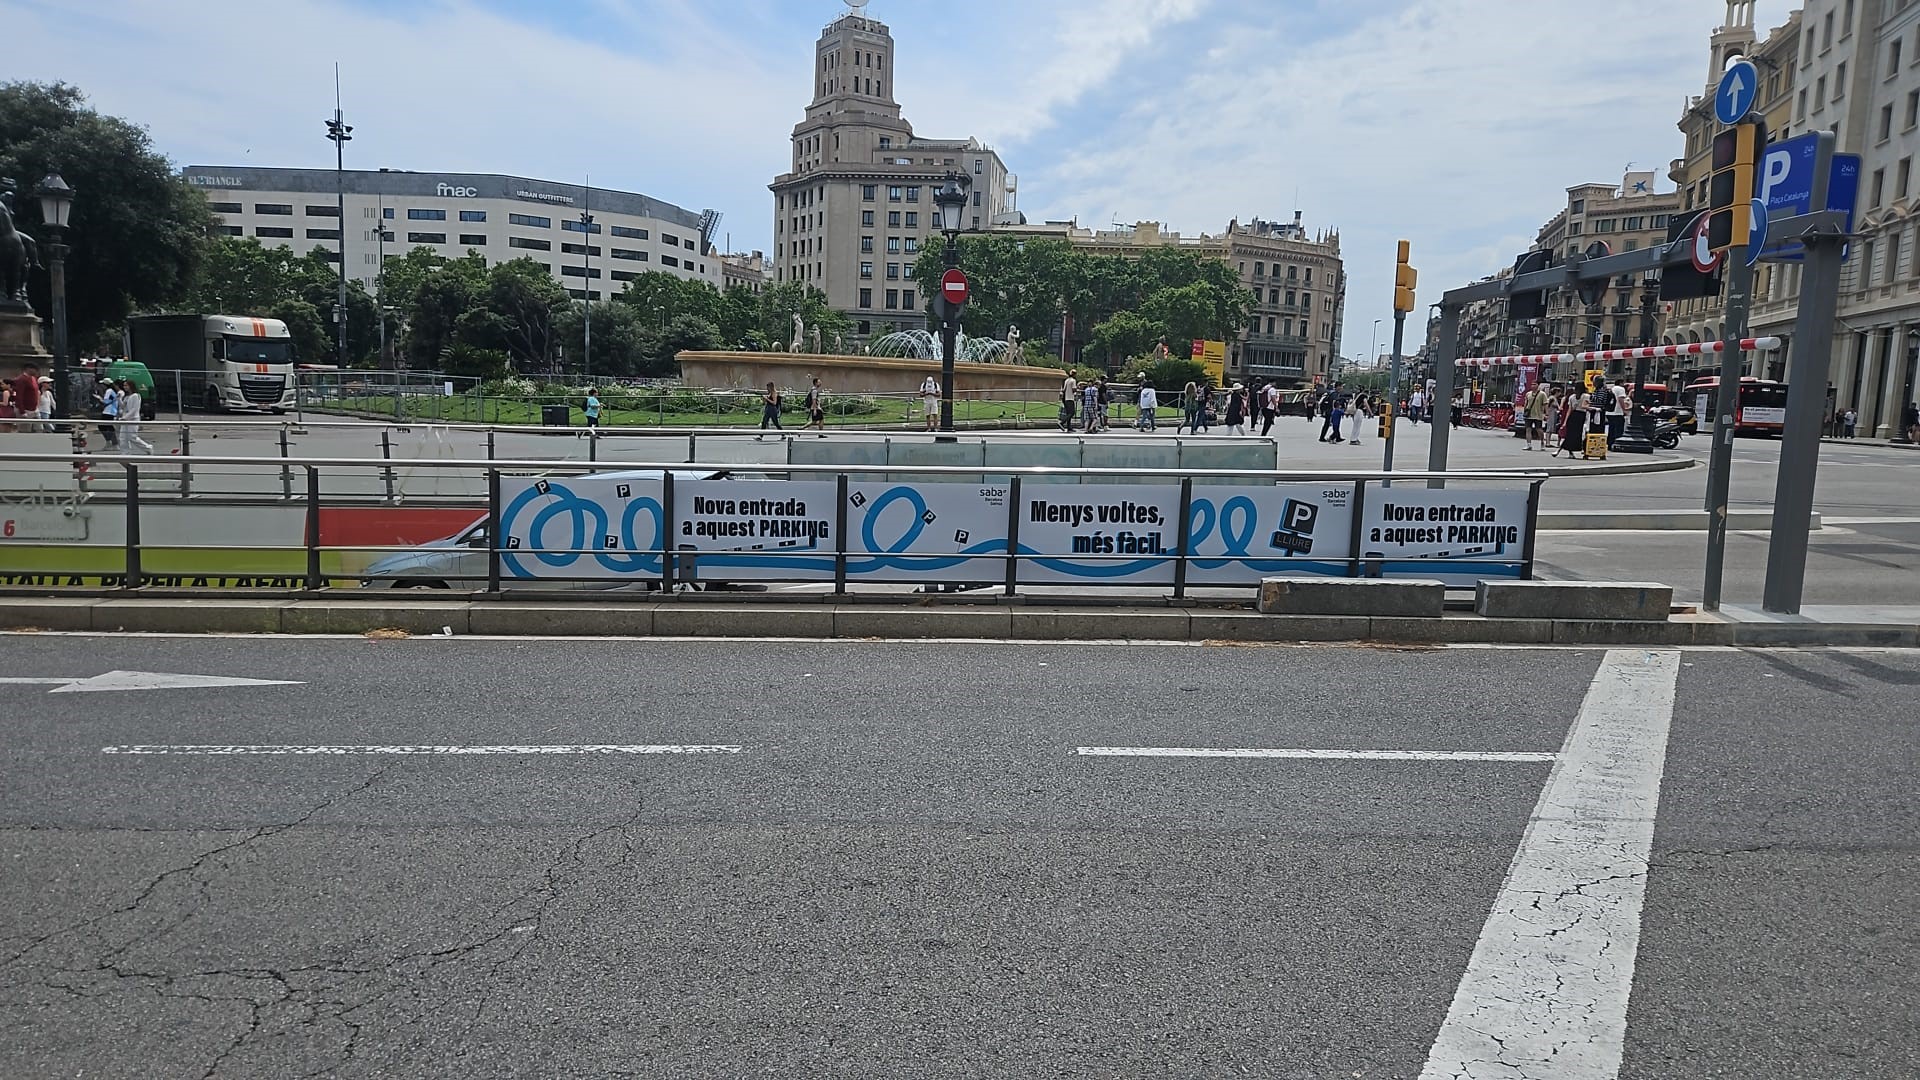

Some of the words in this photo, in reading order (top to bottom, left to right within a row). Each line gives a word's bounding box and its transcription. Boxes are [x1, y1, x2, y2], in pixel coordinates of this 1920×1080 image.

[1841, 165, 1855, 173] 24h
[1761, 150, 1792, 206] P
[436, 182, 478, 198] fnac
[516, 190, 538, 200] URBAN
[538, 192, 574, 203] OUTFITTERS
[621, 485, 629, 497] P
[979, 487, 1003, 497] saba
[1322, 488, 1346, 498] saba
[694, 496, 735, 515] Nova
[738, 497, 806, 517] entrada
[1030, 501, 1094, 527] Menys
[1097, 504, 1165, 527] voltes,
[1291, 503, 1312, 527] P
[1383, 503, 1426, 522] Nova
[1428, 504, 1496, 523] entrada
[4, 519, 16, 537] 6
[682, 521, 693, 536] a
[696, 521, 755, 540] aquest
[759, 519, 829, 539] PARKING
[958, 531, 966, 542] P
[1370, 529, 1380, 542] a
[1384, 528, 1443, 546] aquest
[1448, 525, 1517, 544] PARKING
[608, 536, 616, 548] P
[1073, 531, 1113, 554] més
[1116, 531, 1167, 555] fàcil.
[1276, 534, 1310, 549] LLIURE
